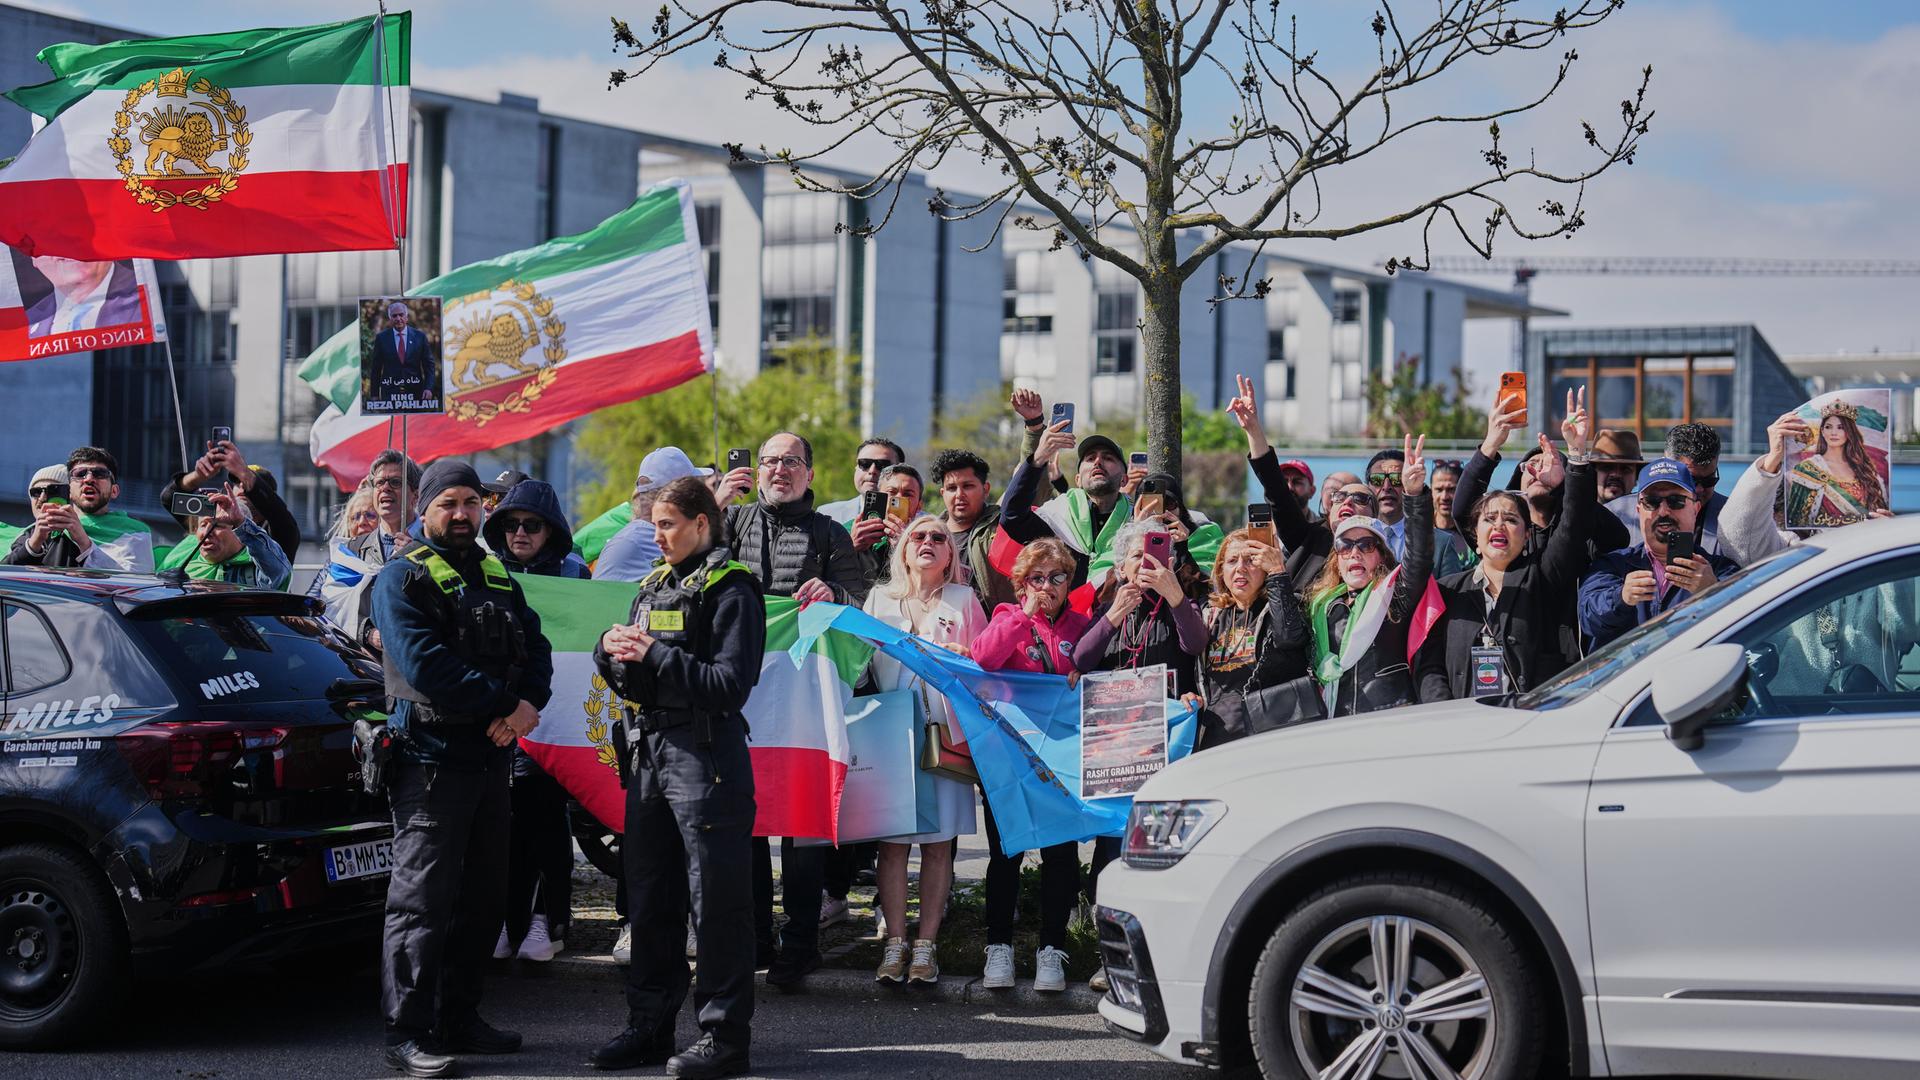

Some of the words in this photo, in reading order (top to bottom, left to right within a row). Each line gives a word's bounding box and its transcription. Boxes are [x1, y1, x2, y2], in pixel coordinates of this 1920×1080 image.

[406, 376, 421, 384] شاه
[390, 393, 414, 401] KING
[366, 400, 394, 410] REZA
[395, 399, 439, 409] PAHLAVI
[652, 614, 682, 627] POLIZEI
[199, 670, 260, 700] MILES
[5, 693, 121, 735] MILES
[3, 739, 58, 753] Carsharing
[59, 738, 84, 751] nach
[85, 738, 101, 750] km
[347, 771, 361, 781] PO
[1086, 768, 1110, 779] RASHT
[1110, 766, 1135, 777] GRAND
[1136, 762, 1164, 774] BAZAAR
[334, 850, 347, 876] B
[354, 845, 377, 873] MM
